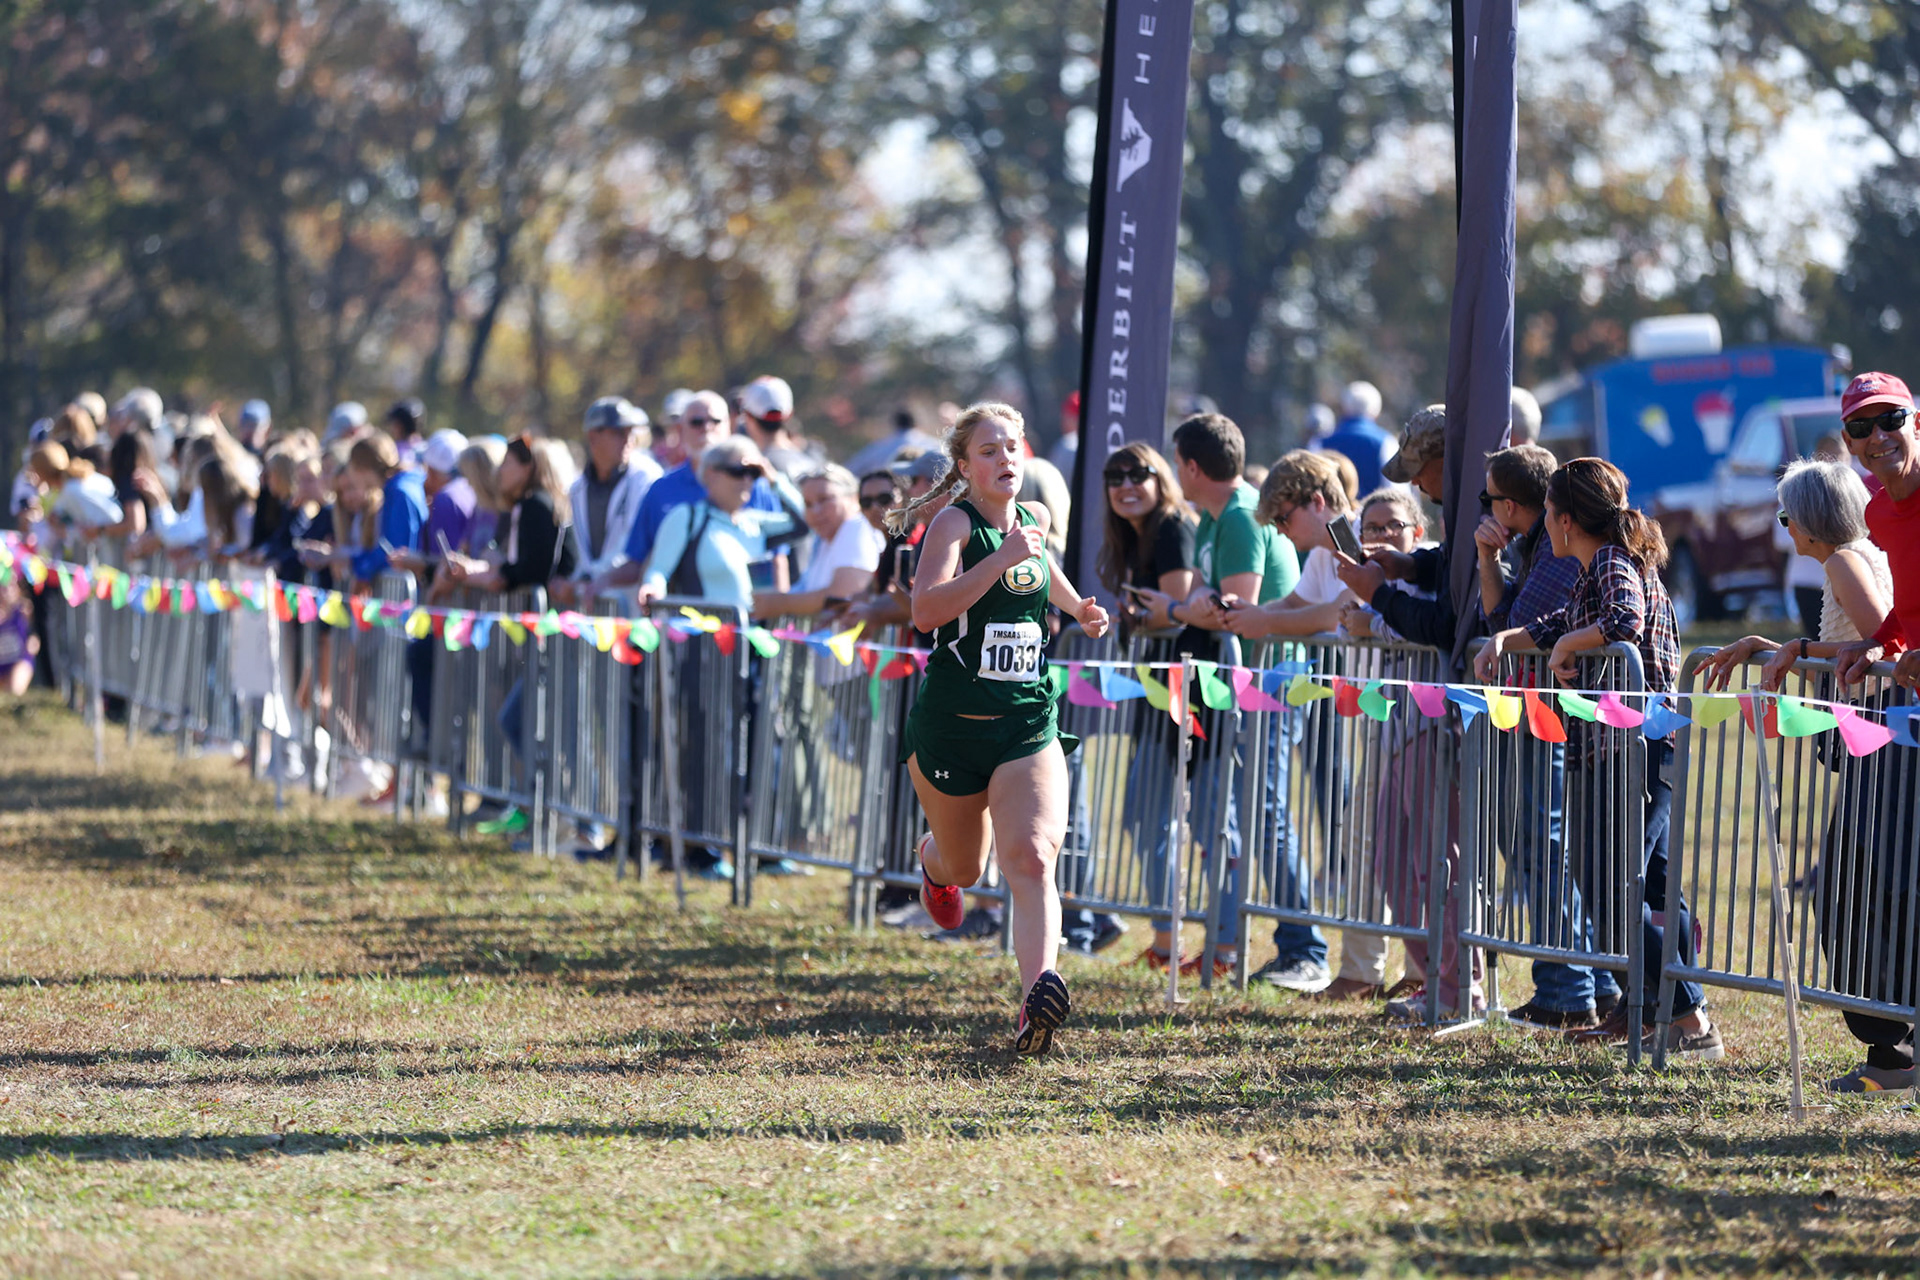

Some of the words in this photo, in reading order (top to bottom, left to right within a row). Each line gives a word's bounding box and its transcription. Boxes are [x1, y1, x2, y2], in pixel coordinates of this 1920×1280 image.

[1134, 0, 1159, 85] HE
[1012, 564, 1037, 588] B
[993, 630, 1016, 639] TMSAA
[986, 644, 1036, 673] 1033
